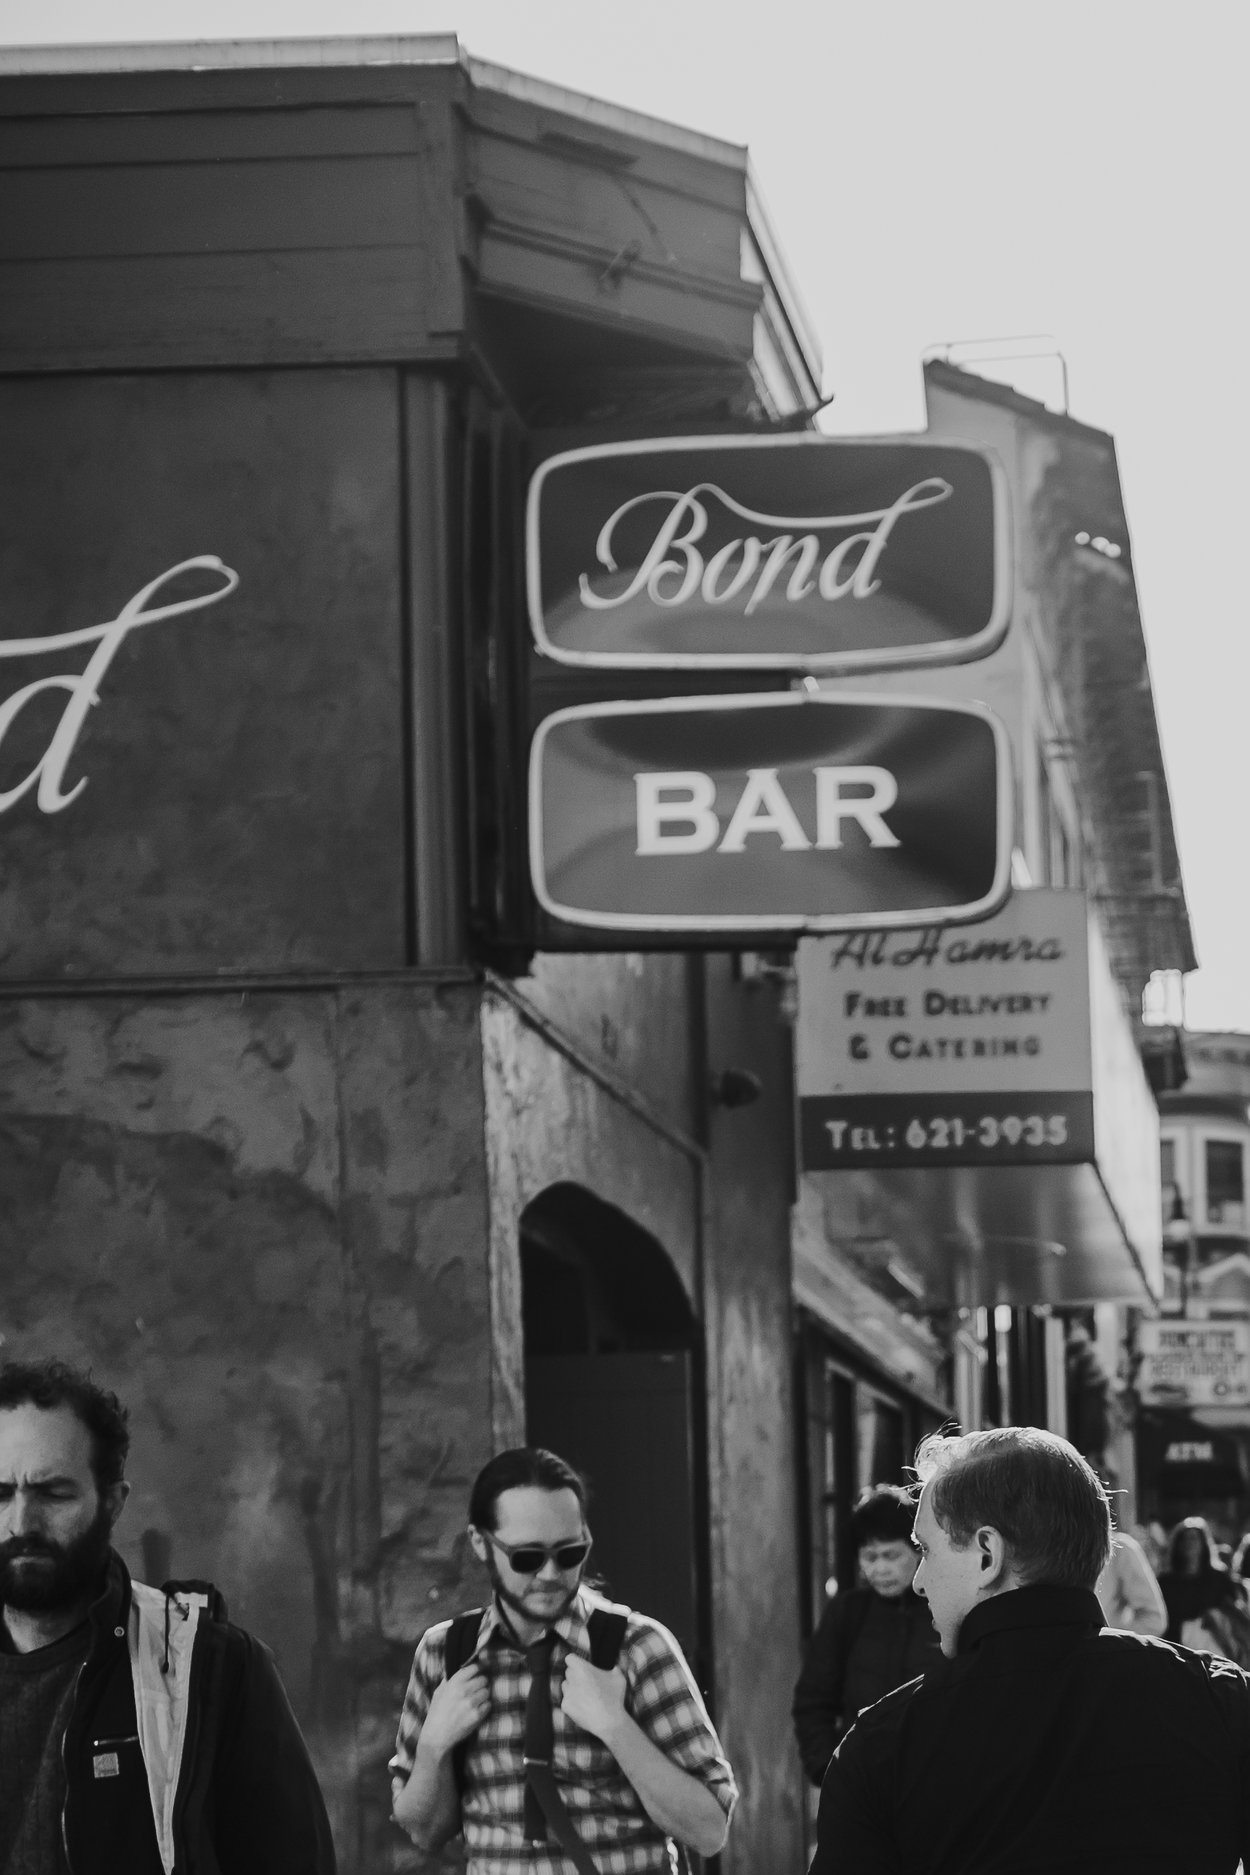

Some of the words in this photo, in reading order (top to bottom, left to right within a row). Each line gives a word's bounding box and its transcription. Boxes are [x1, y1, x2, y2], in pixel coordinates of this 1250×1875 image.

[579, 477, 953, 615] Bond
[633, 764, 902, 857] BAR
[850, 1034, 869, 1060] &
[888, 1033, 1041, 1060] CATERING
[825, 1119, 896, 1150] TEL:
[905, 1114, 1069, 1149] 621-3935
